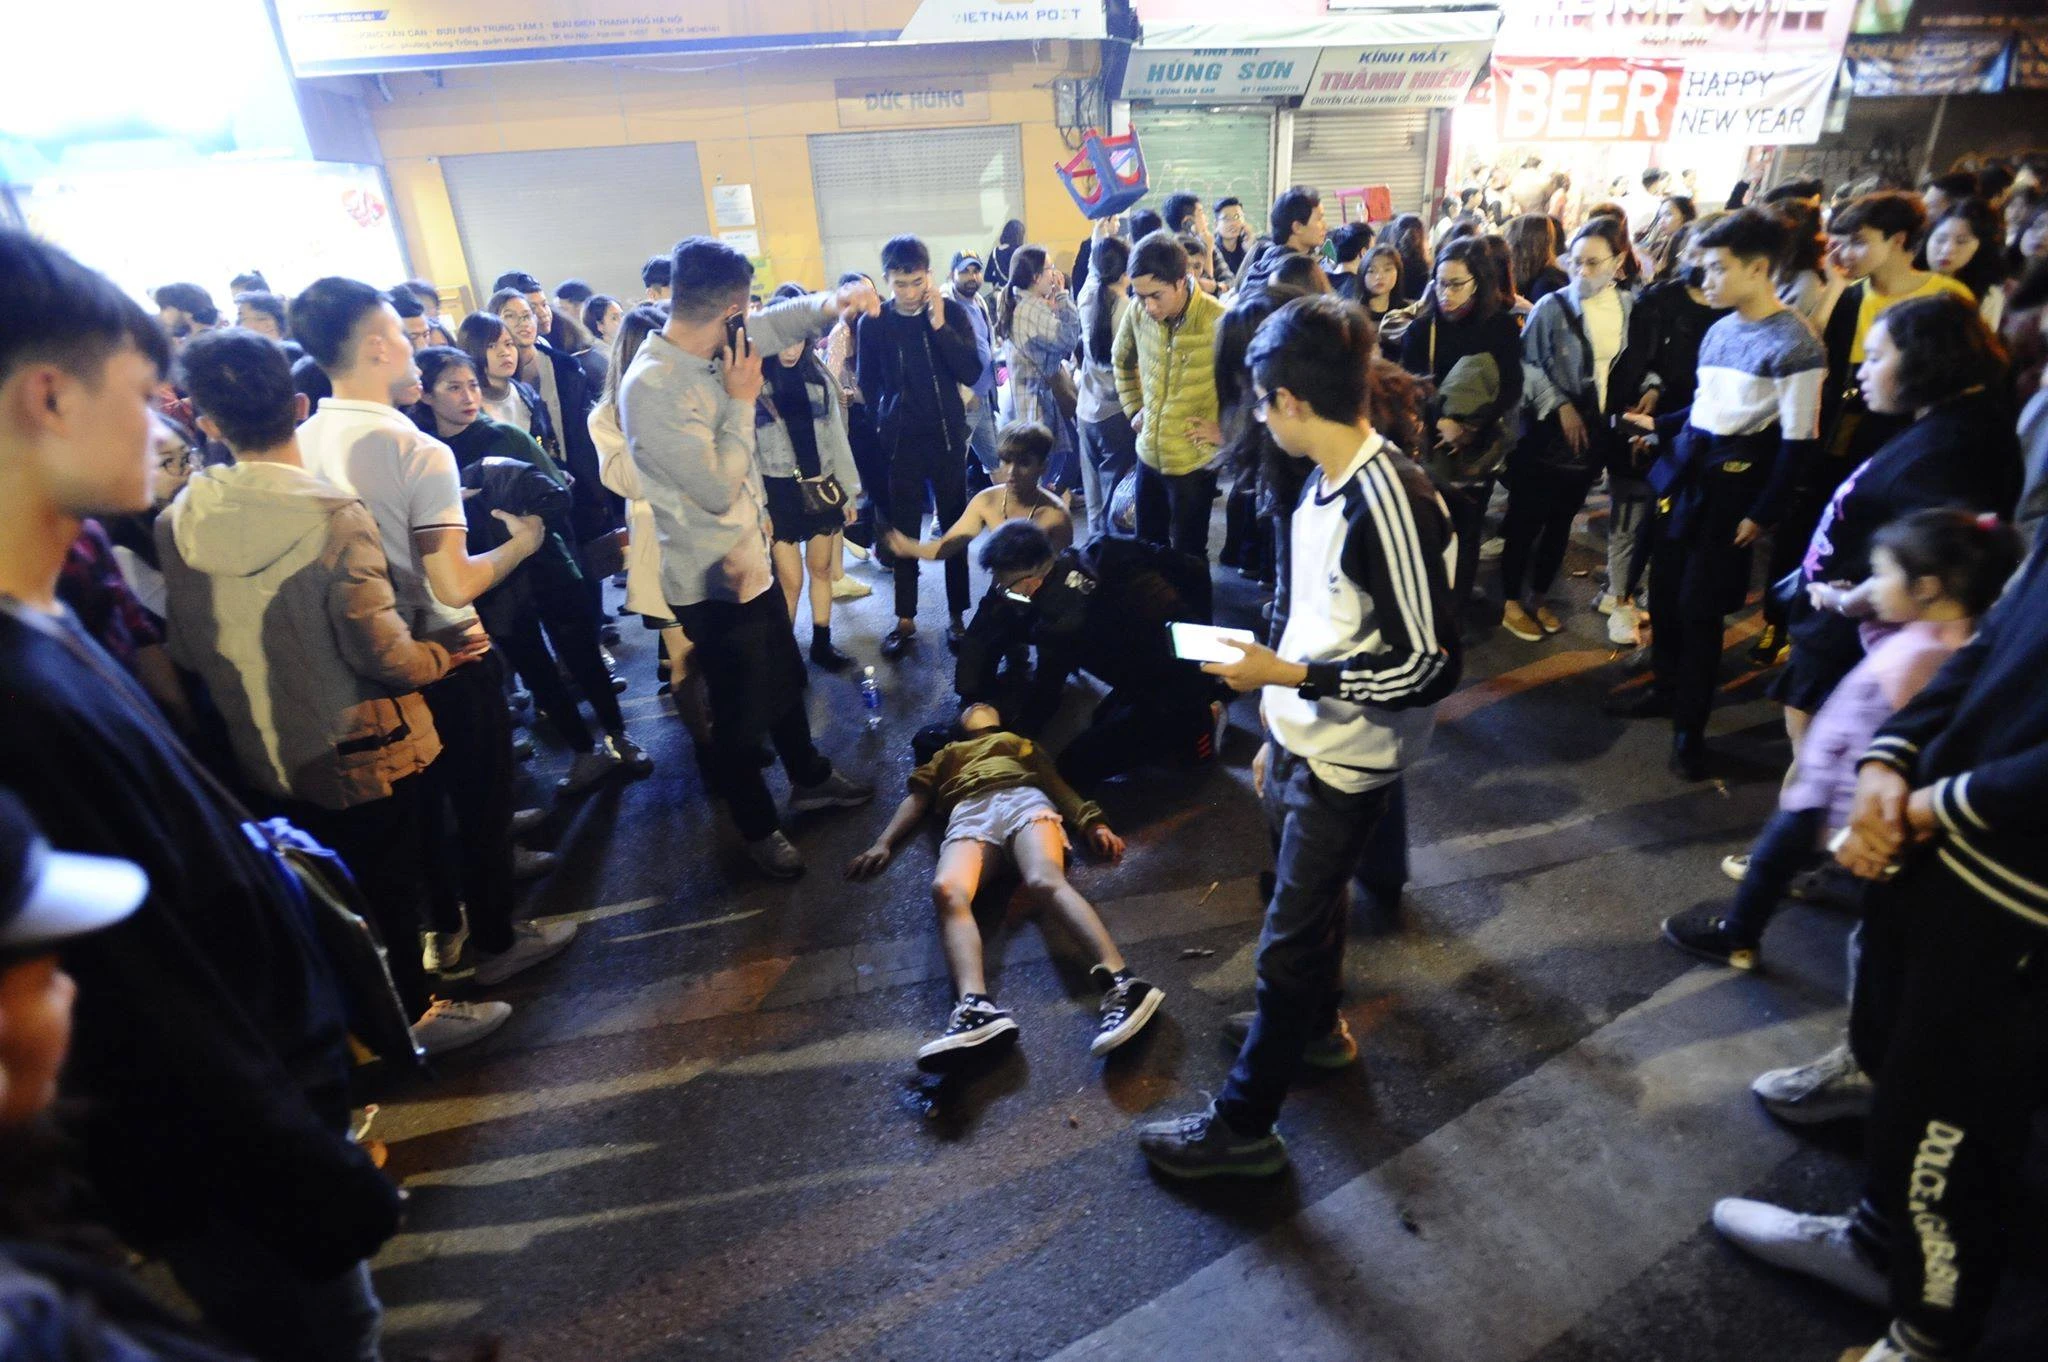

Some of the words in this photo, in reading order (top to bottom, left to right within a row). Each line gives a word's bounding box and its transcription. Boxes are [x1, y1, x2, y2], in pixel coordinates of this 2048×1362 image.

[1685, 71, 1774, 97] HAPPY
[1502, 69, 1668, 137] BEER
[1679, 108, 1738, 134] NEW
[1745, 107, 1807, 134] YEAR
